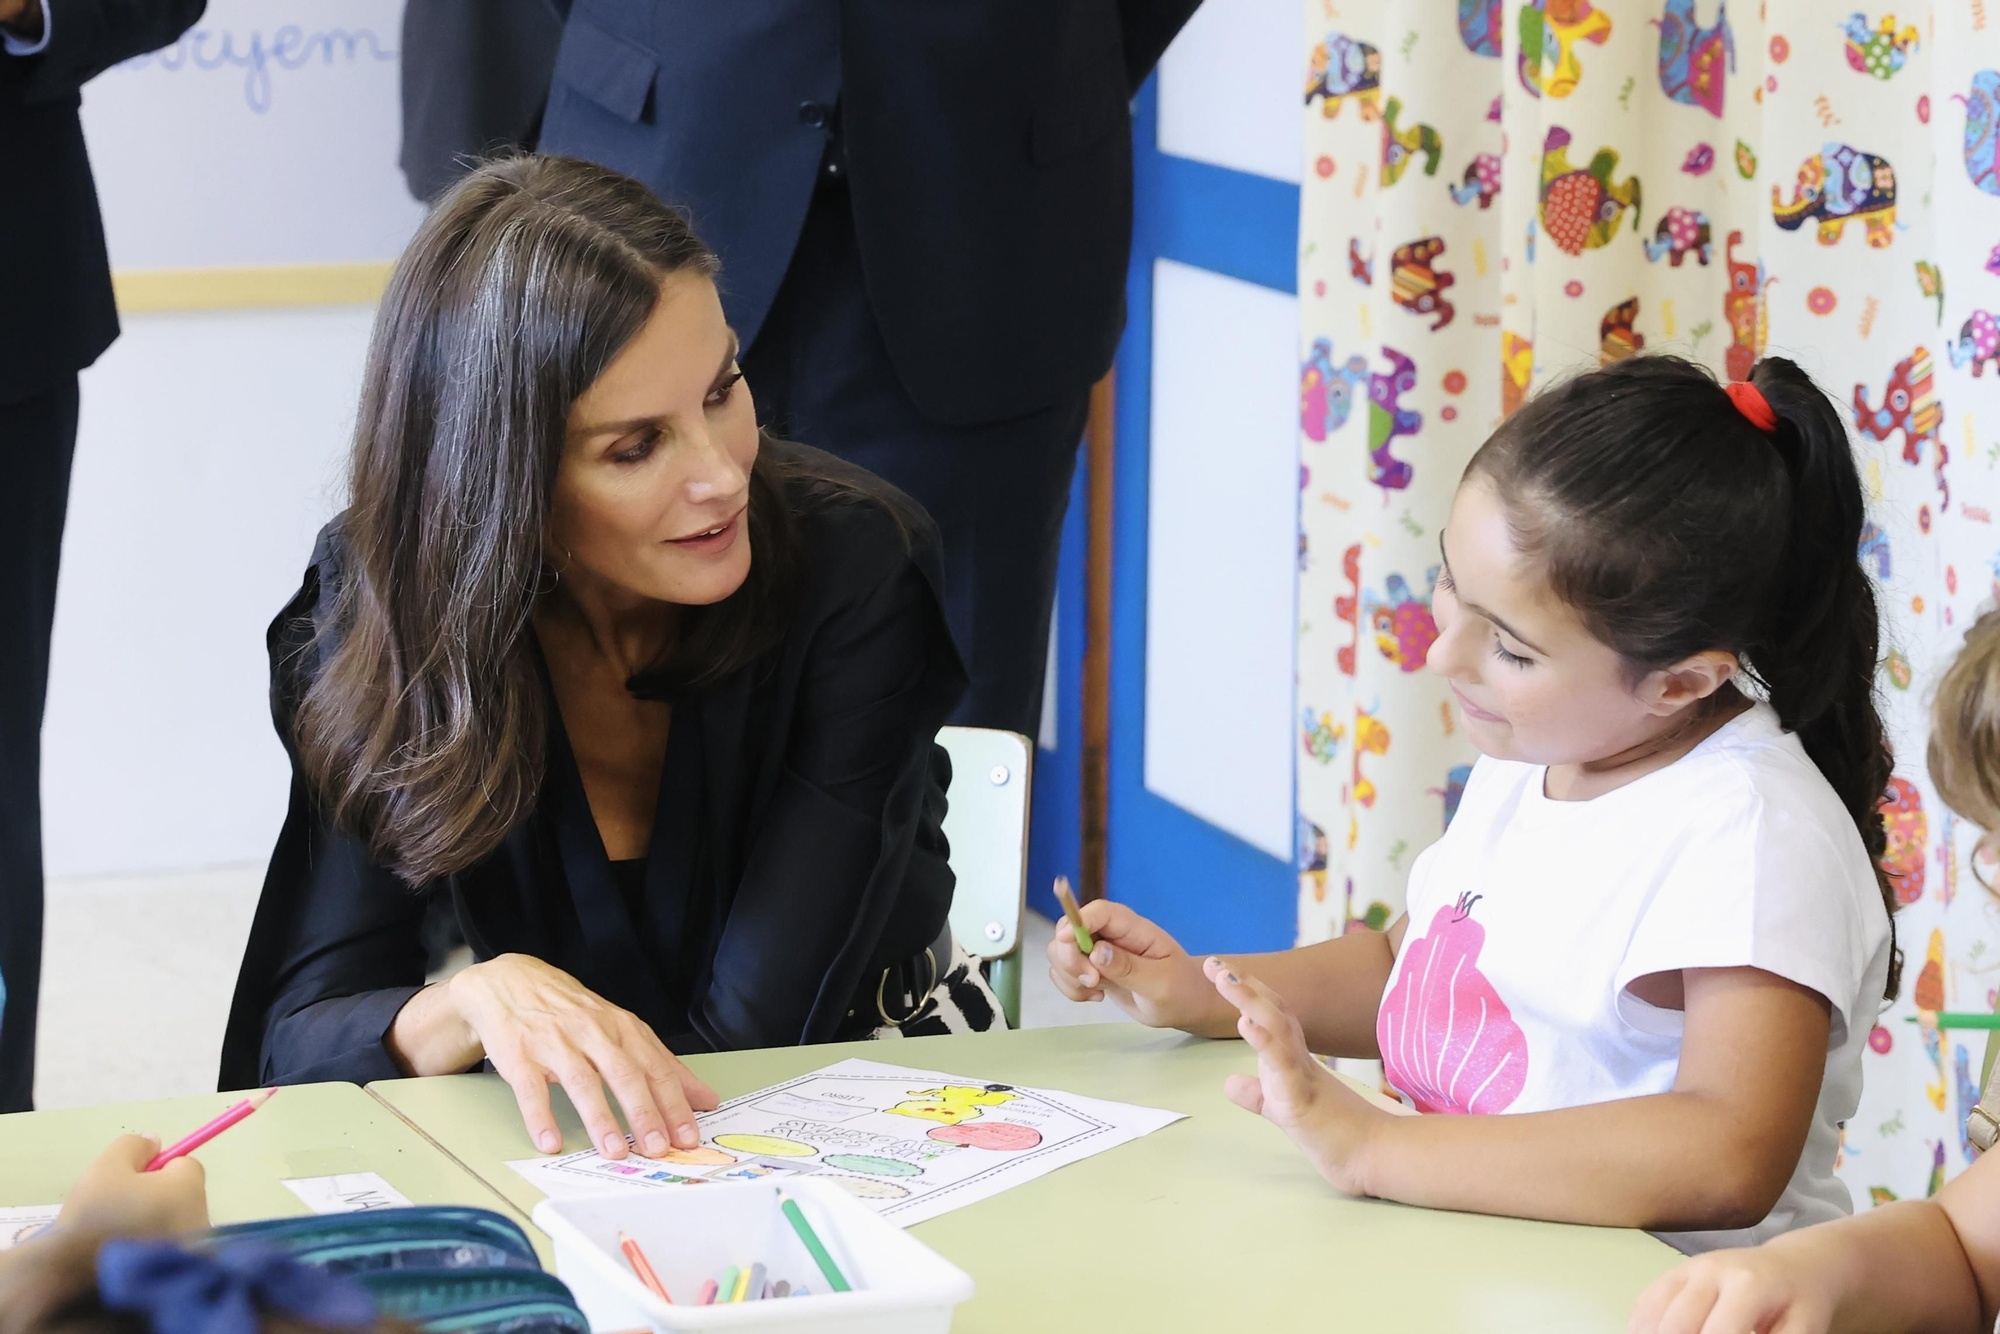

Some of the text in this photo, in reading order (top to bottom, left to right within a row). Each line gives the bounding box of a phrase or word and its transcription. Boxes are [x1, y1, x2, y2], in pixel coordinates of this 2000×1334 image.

[821, 1092, 865, 1102] LIBRO
[1003, 1117, 1043, 1127] FRUTA
[764, 1126, 870, 1148] COSAS
[779, 1120, 961, 1154] FAVORITAS
